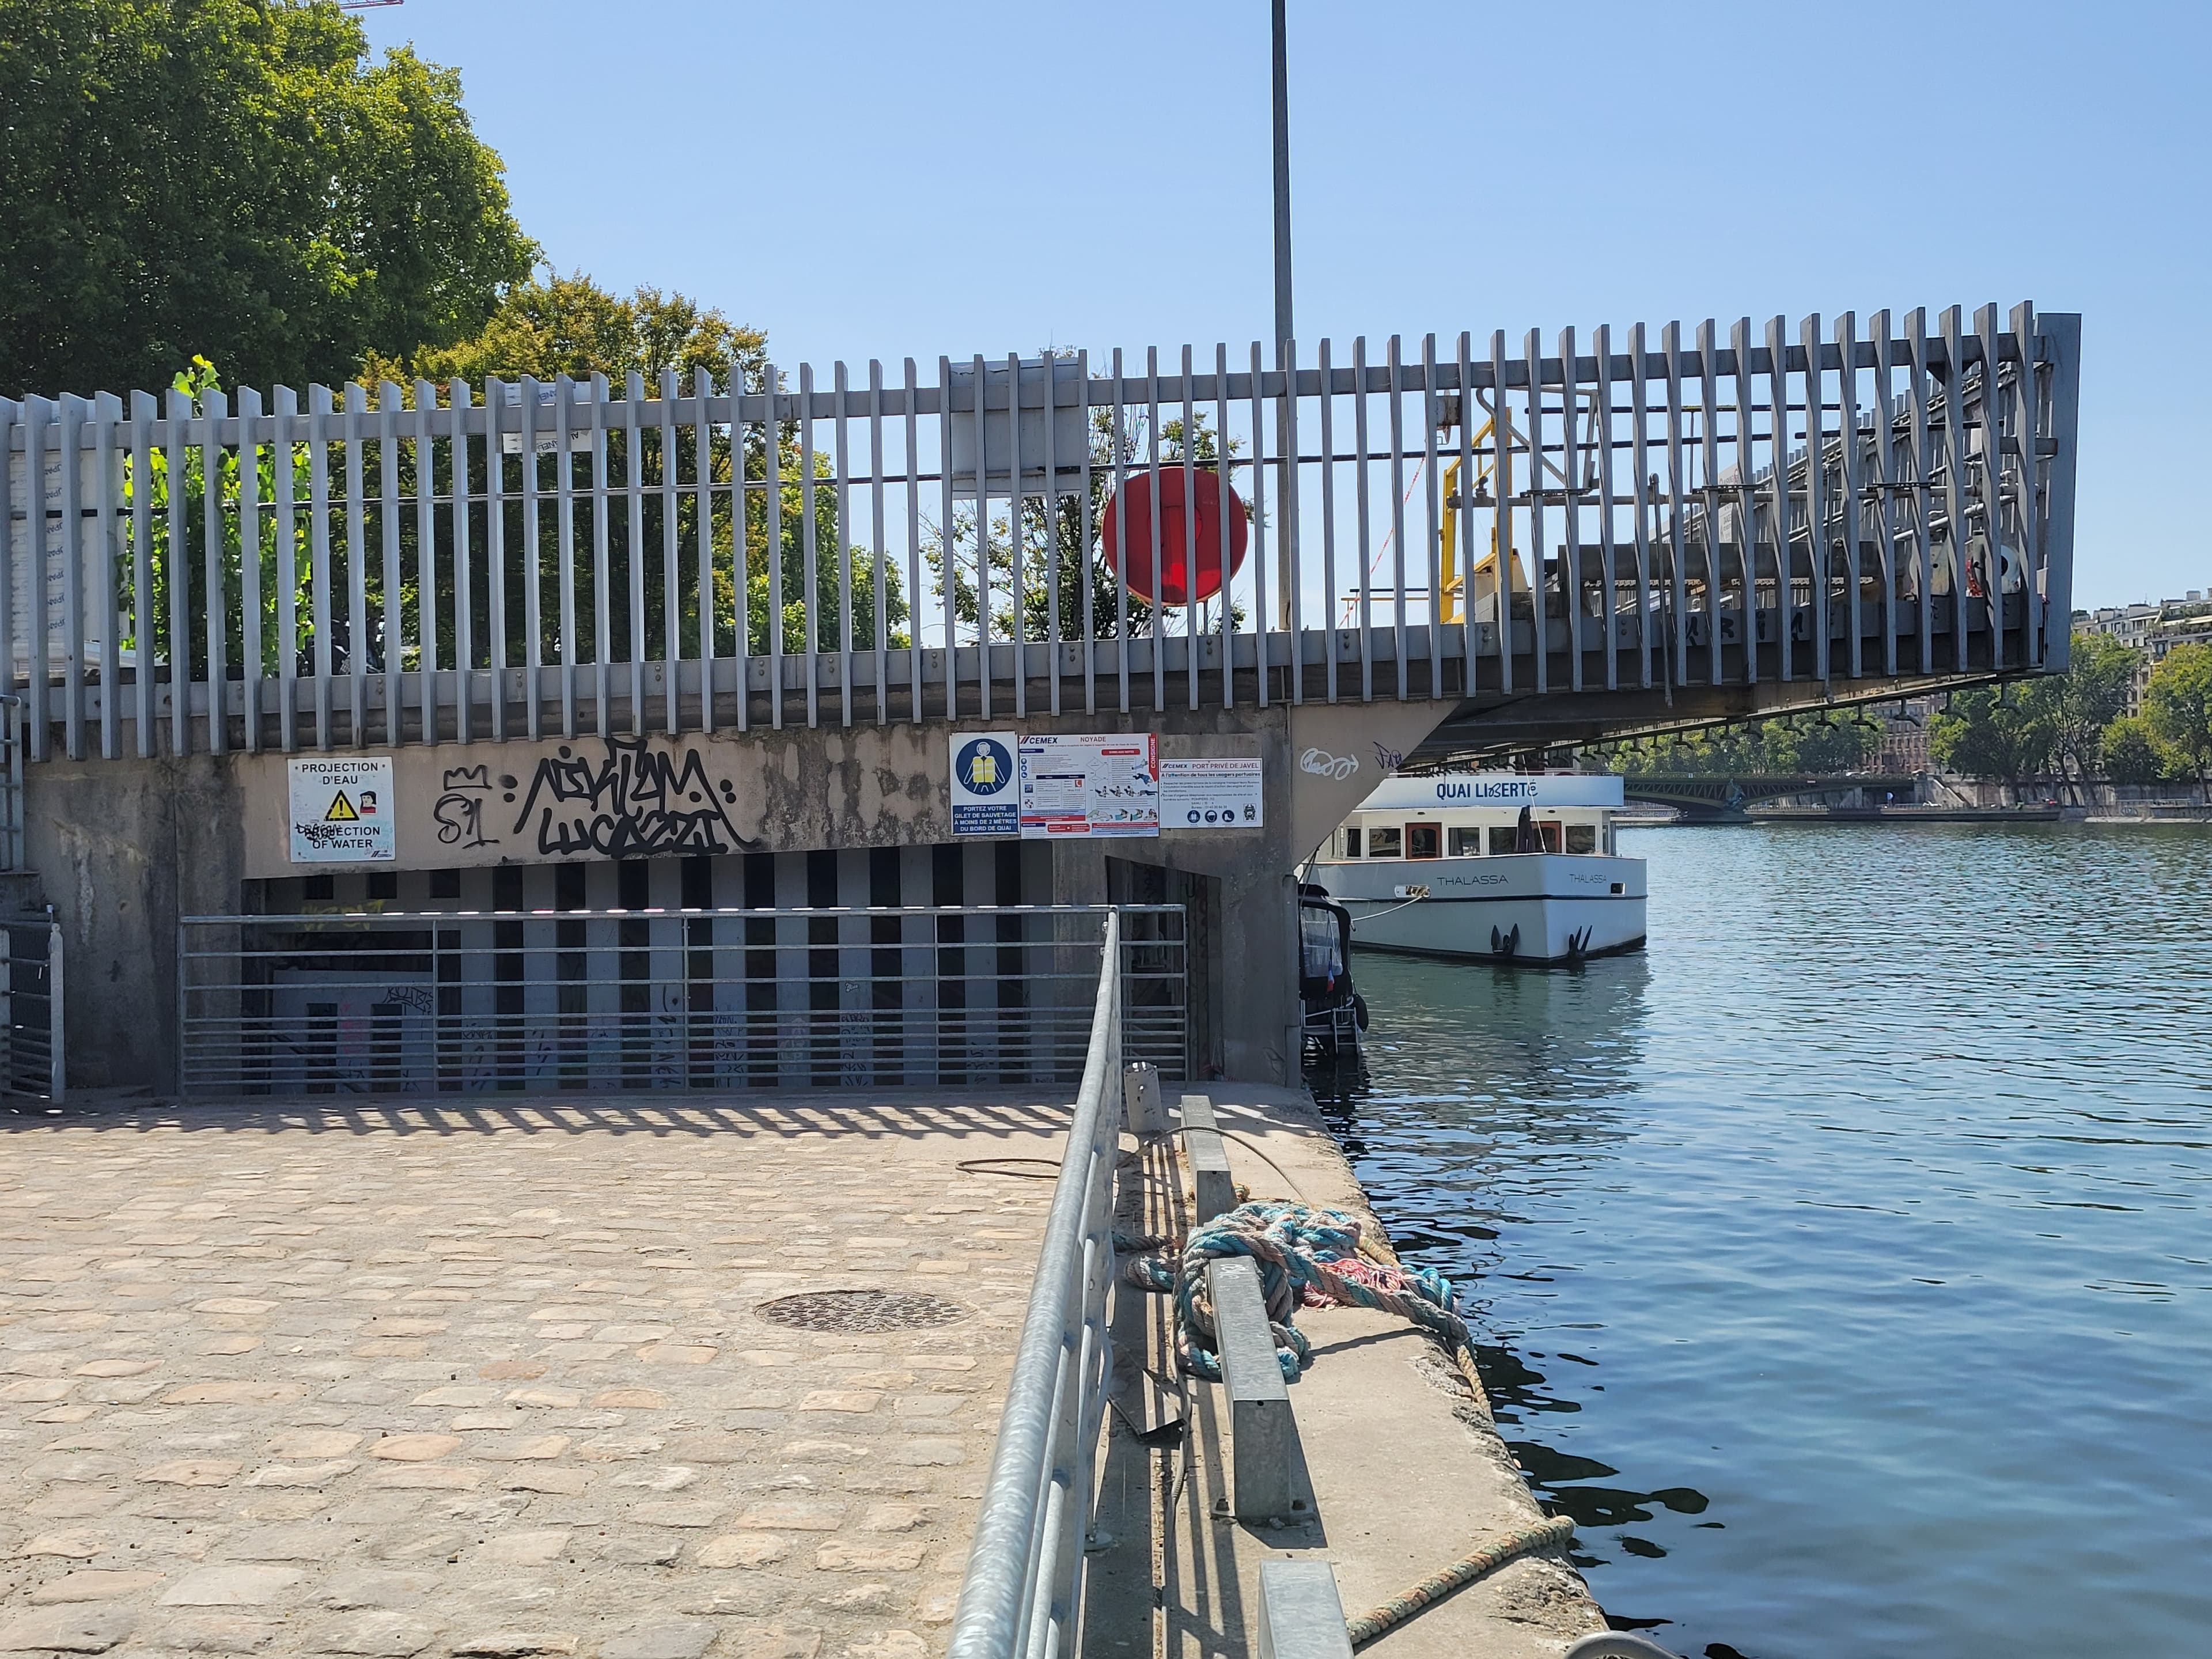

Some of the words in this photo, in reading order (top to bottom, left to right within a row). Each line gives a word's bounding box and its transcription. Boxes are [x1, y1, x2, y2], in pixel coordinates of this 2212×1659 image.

[302, 763, 378, 772] PROJECTION
[323, 775, 358, 785] D'EAU
[1437, 783, 1471, 800] QUAI
[312, 840, 328, 849] OF
[332, 839, 373, 849] WATER
[1437, 874, 1509, 885] THALASSA
[1569, 874, 1607, 883] THALASSA
